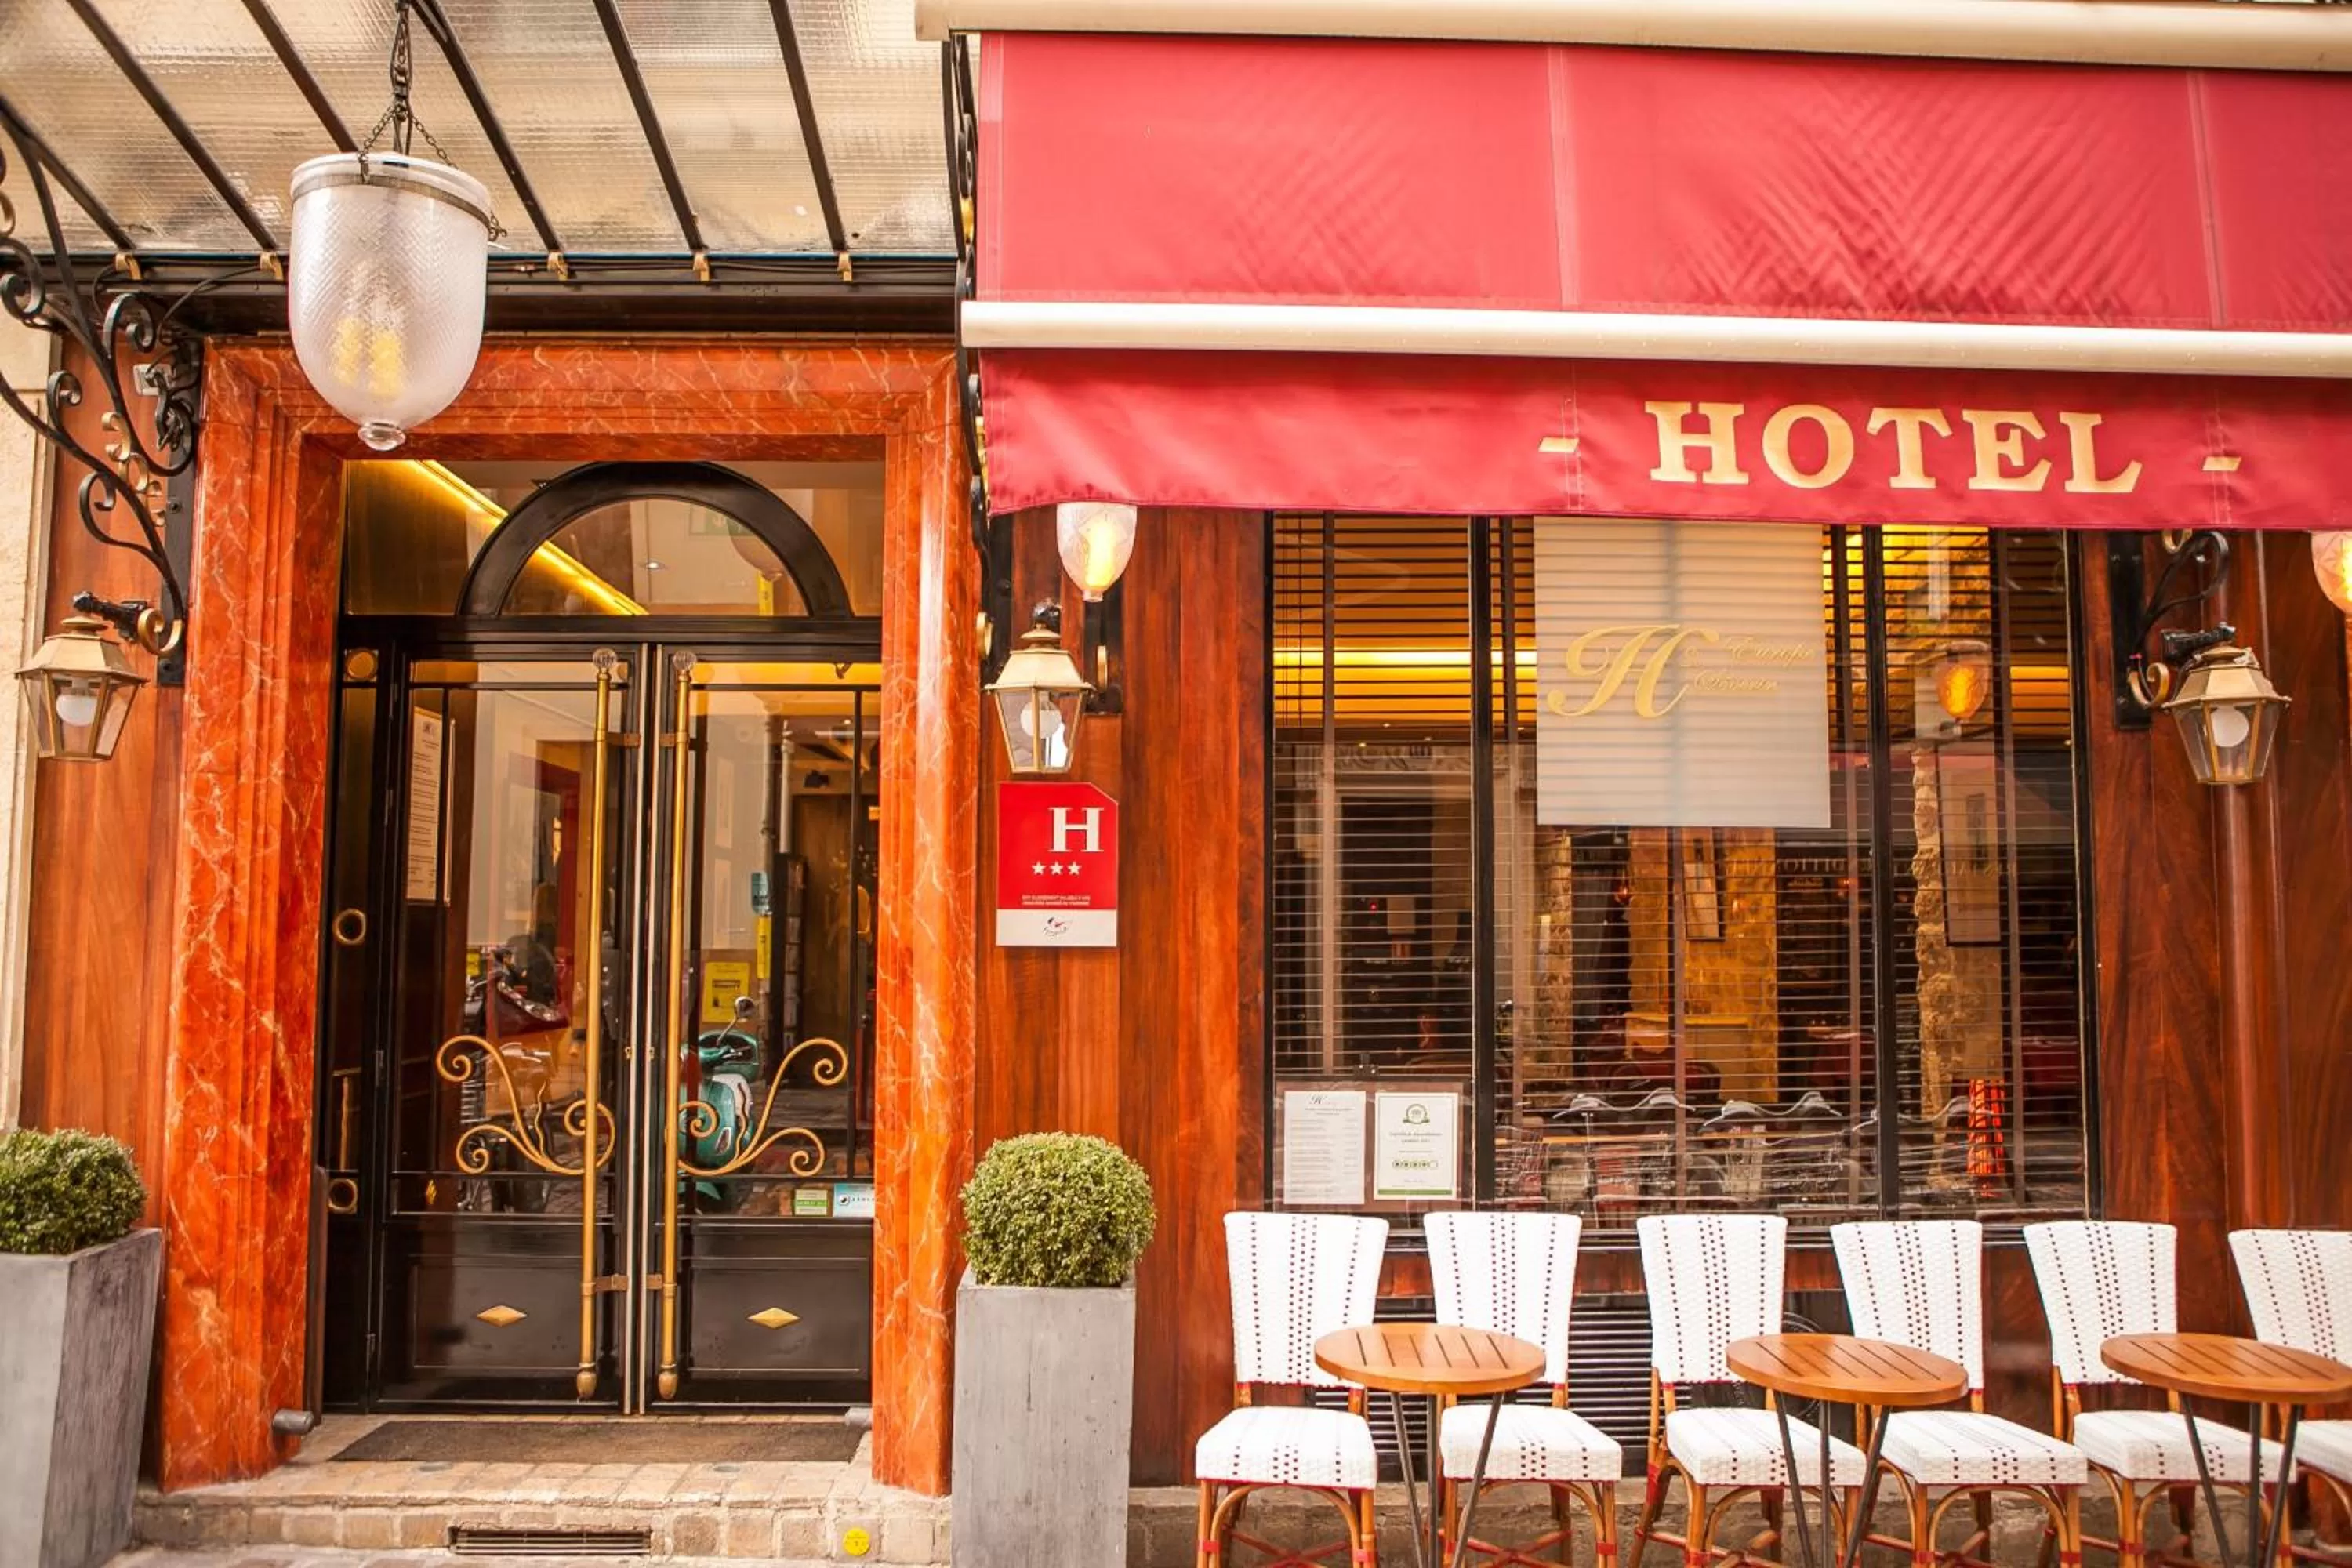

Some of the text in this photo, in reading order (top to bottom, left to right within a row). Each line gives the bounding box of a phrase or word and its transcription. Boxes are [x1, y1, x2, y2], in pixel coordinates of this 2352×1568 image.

[1644, 401, 2143, 494] HOTEL
[1547, 624, 1719, 718] H
[1047, 806, 1105, 852] H
